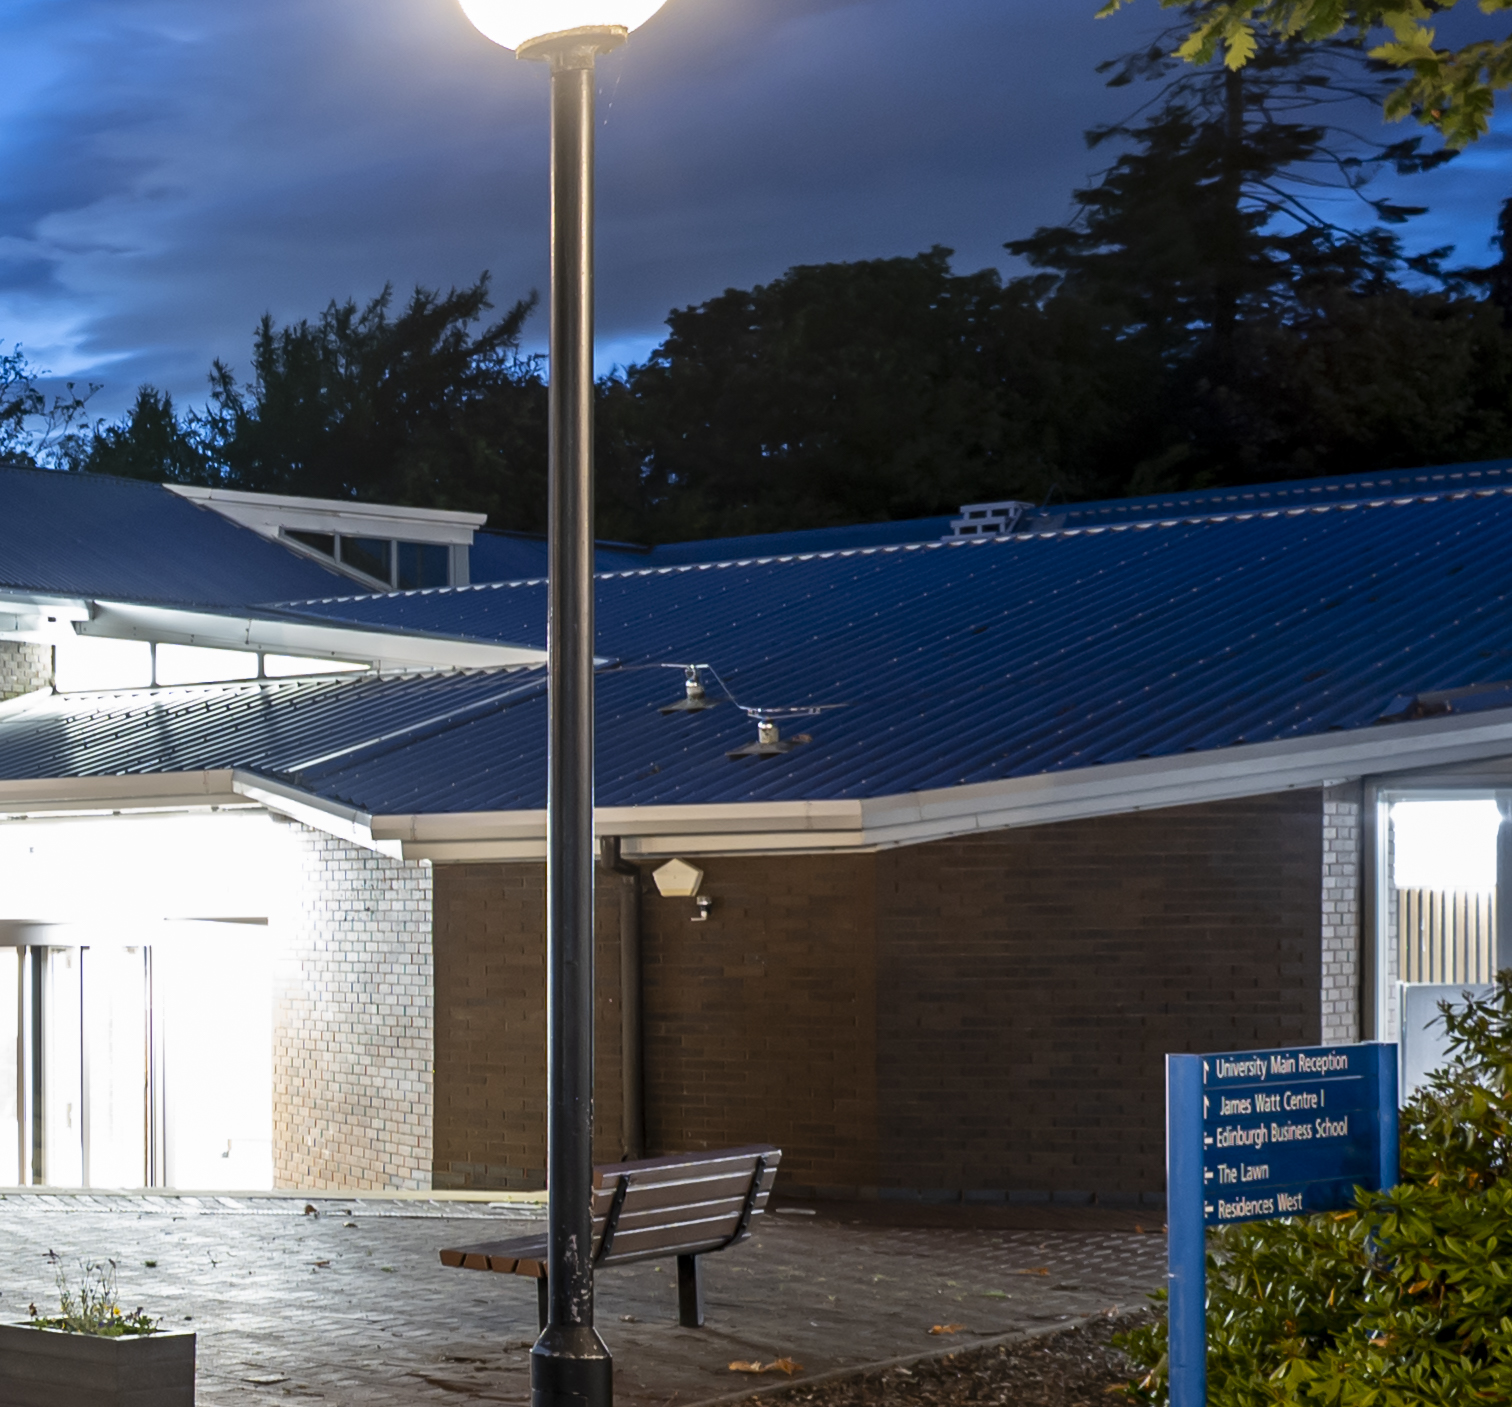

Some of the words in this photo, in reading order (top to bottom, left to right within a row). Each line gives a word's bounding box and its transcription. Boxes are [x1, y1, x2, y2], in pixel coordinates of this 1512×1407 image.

[1216, 1055, 1267, 1080] University
[1270, 1053, 1295, 1074] Main
[1298, 1050, 1348, 1075] Reception
[1220, 1096, 1251, 1115] James
[1254, 1093, 1280, 1113] Watt
[1284, 1091, 1318, 1110] Centre
[1216, 1123, 1268, 1149] Edinburgh
[1270, 1120, 1312, 1142] Business
[1315, 1115, 1348, 1138] School
[1217, 1163, 1237, 1184] The
[1240, 1162, 1269, 1182] Lawn
[1218, 1196, 1274, 1219] Residences
[1277, 1193, 1303, 1212] West
